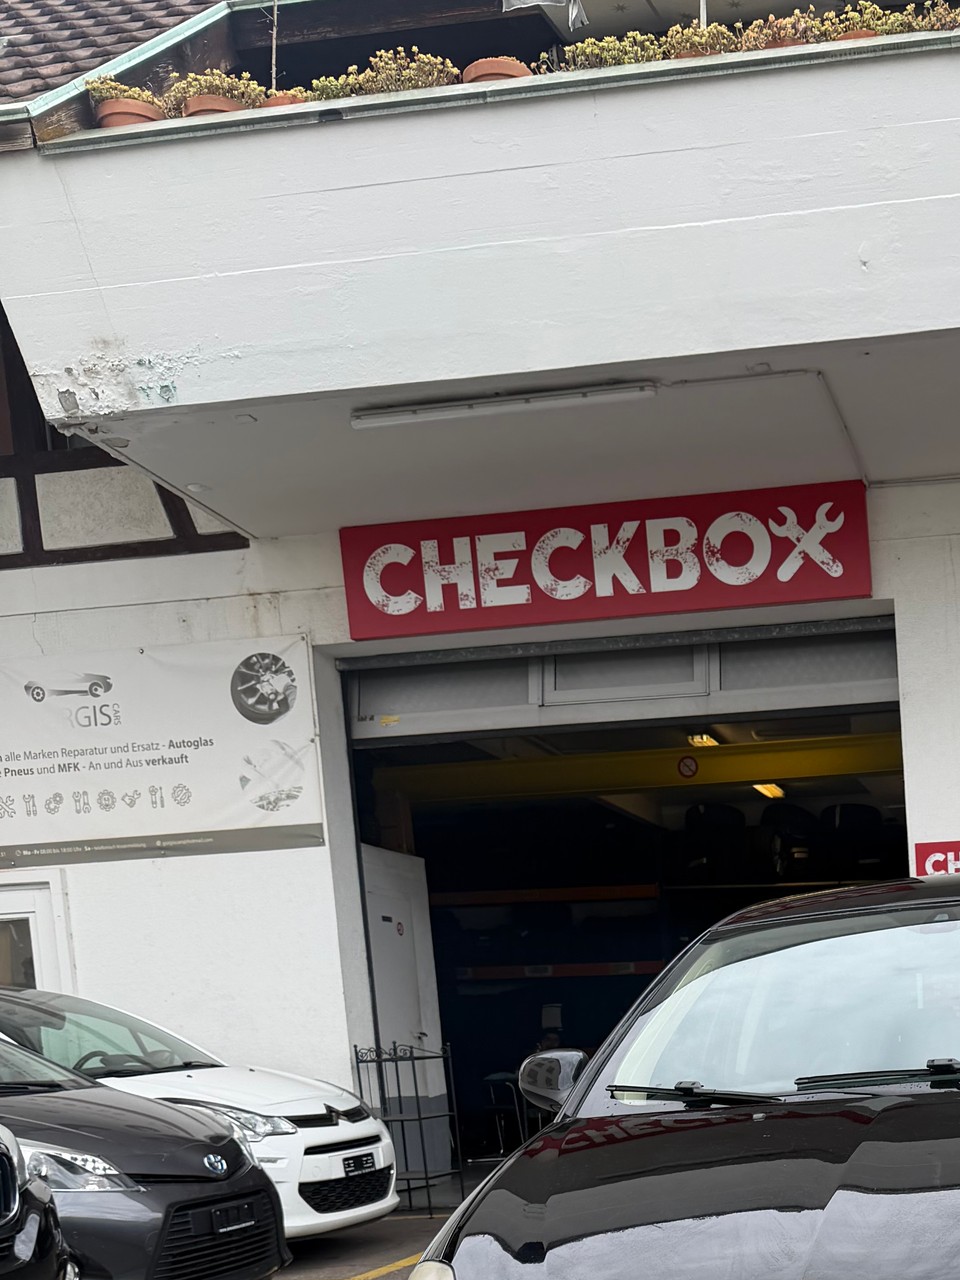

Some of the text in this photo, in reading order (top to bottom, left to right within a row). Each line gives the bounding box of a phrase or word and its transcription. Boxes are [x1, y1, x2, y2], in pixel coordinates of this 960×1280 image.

[363, 501, 845, 615] CHECKBOX
[112, 703, 121, 726] CARS
[4, 751, 21, 762] alle
[23, 749, 59, 761] Marken
[61, 746, 108, 759] Reparatur
[110, 742, 129, 754] und
[131, 741, 160, 753] Ersatz
[168, 736, 214, 750] Autoglas
[4, 767, 35, 777] Pneus
[37, 763, 56, 775] und
[58, 762, 80, 773] MFK
[88, 761, 102, 771] An
[104, 759, 123, 770] und
[125, 758, 144, 769] Aus
[145, 753, 189, 767] verkauft
